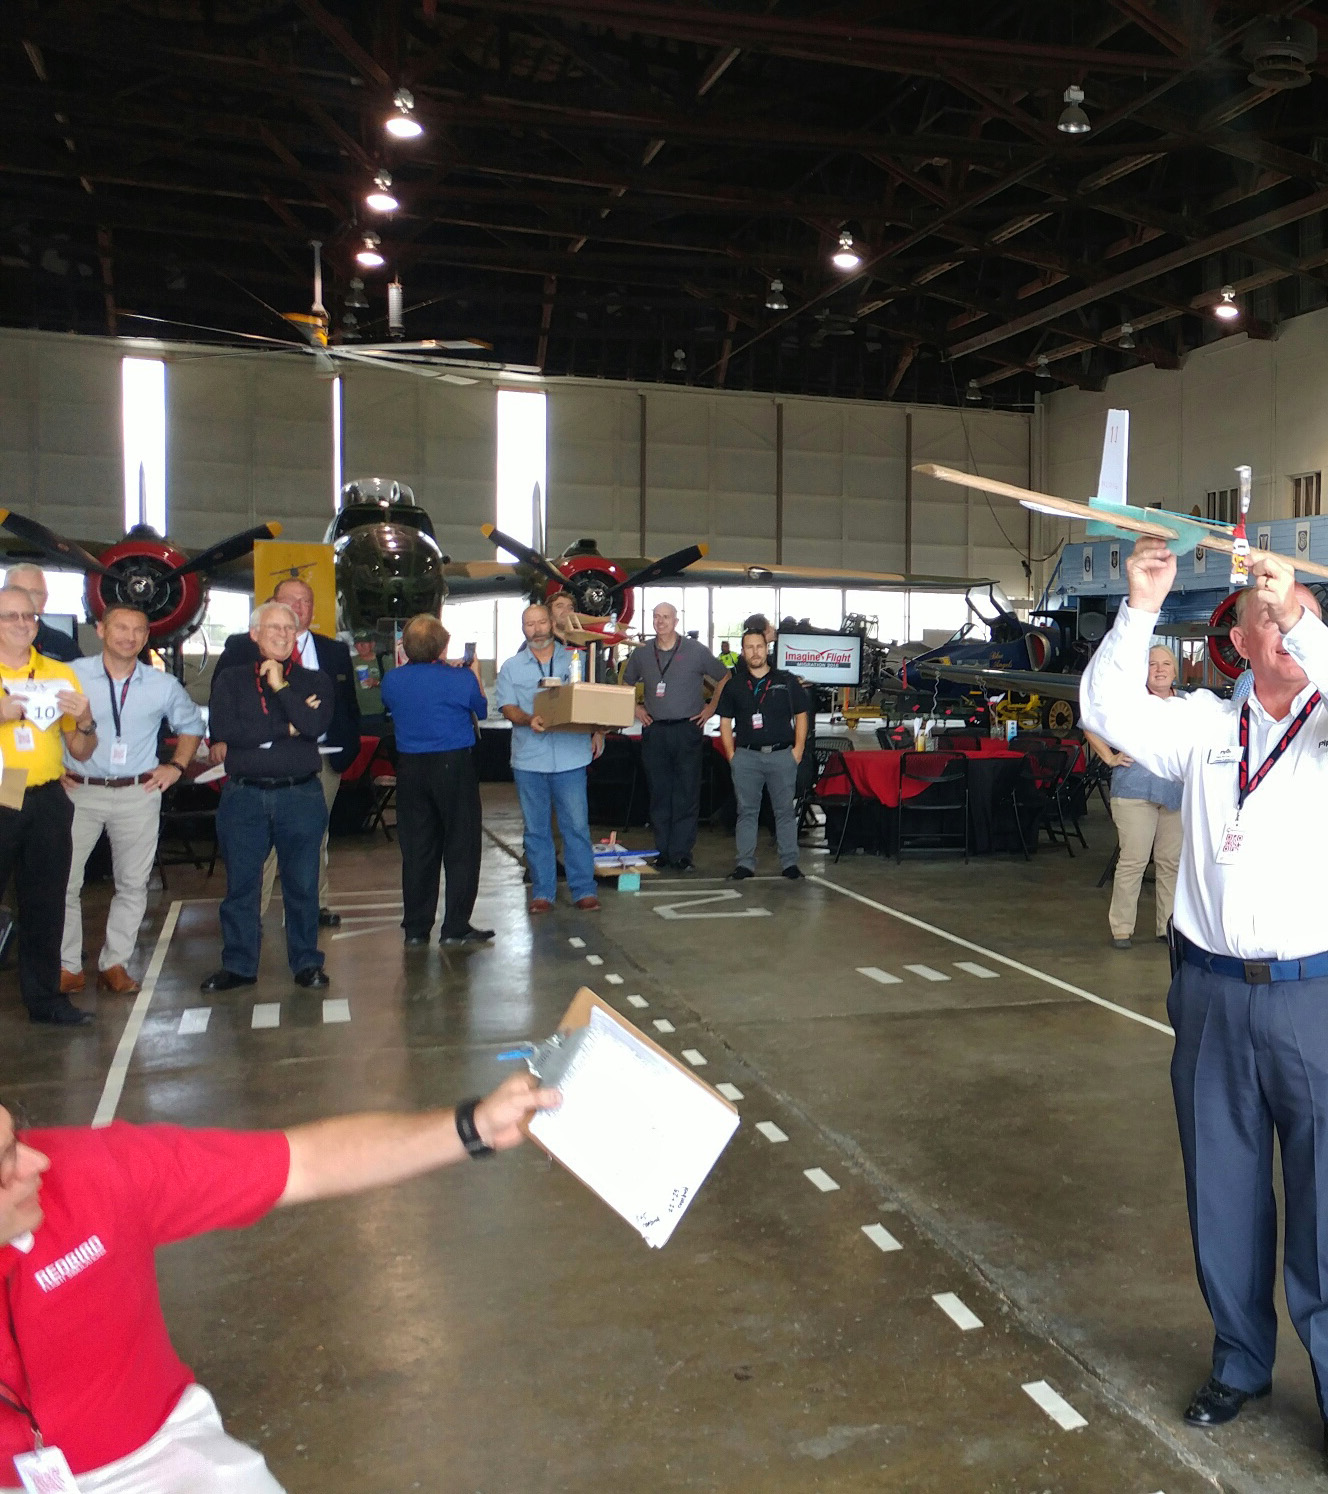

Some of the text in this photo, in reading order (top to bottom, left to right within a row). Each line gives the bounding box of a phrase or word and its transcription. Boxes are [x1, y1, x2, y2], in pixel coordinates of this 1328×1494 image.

[785, 651, 851, 664] Imagine Flight
[34, 705, 56, 720] 10
[34, 1234, 106, 1288] REDBIRD
